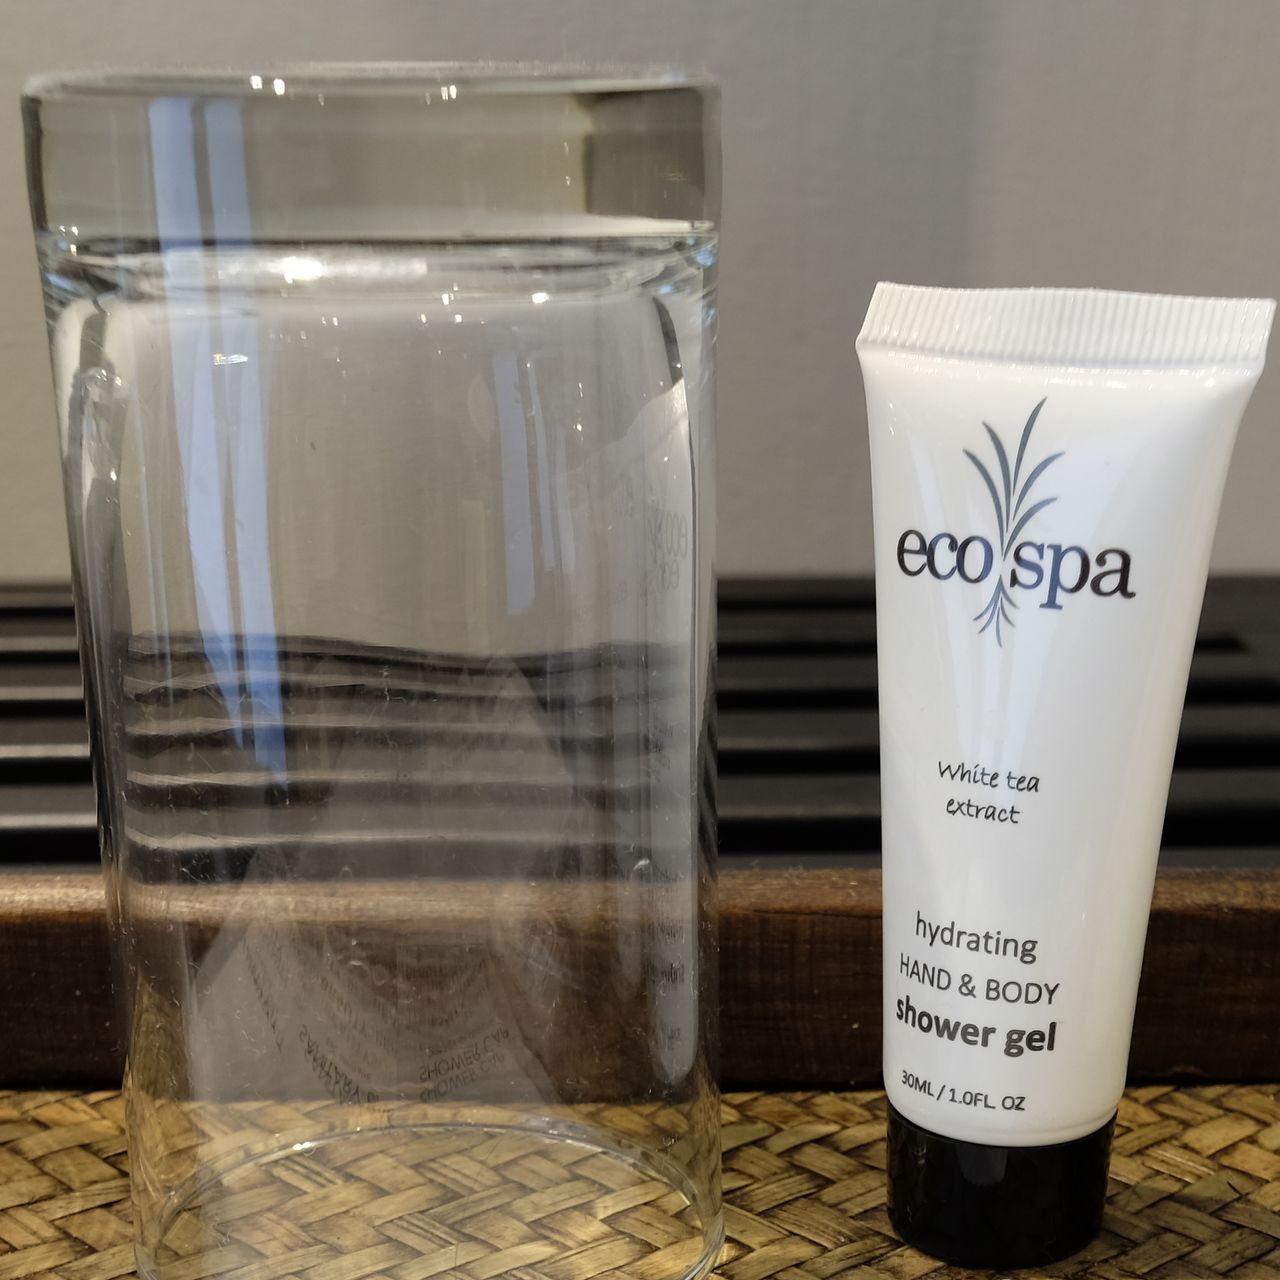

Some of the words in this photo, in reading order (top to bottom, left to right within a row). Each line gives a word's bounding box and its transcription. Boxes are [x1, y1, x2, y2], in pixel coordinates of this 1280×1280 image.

[897, 529, 994, 584] eco
[1010, 541, 1137, 610] spa
[938, 760, 1000, 788] White
[1006, 770, 1041, 793] tea
[945, 797, 1021, 824] extract
[916, 910, 1039, 965] hydrating
[900, 952, 952, 992] HAND
[958, 973, 977, 998] &
[985, 980, 1061, 1006] BODY
[896, 996, 997, 1048] shower
[1004, 1021, 1058, 1058] gel
[901, 1069, 934, 1098] 30ML
[948, 1086, 997, 1110] 1.0FL
[1001, 1094, 1027, 1112] OZ
